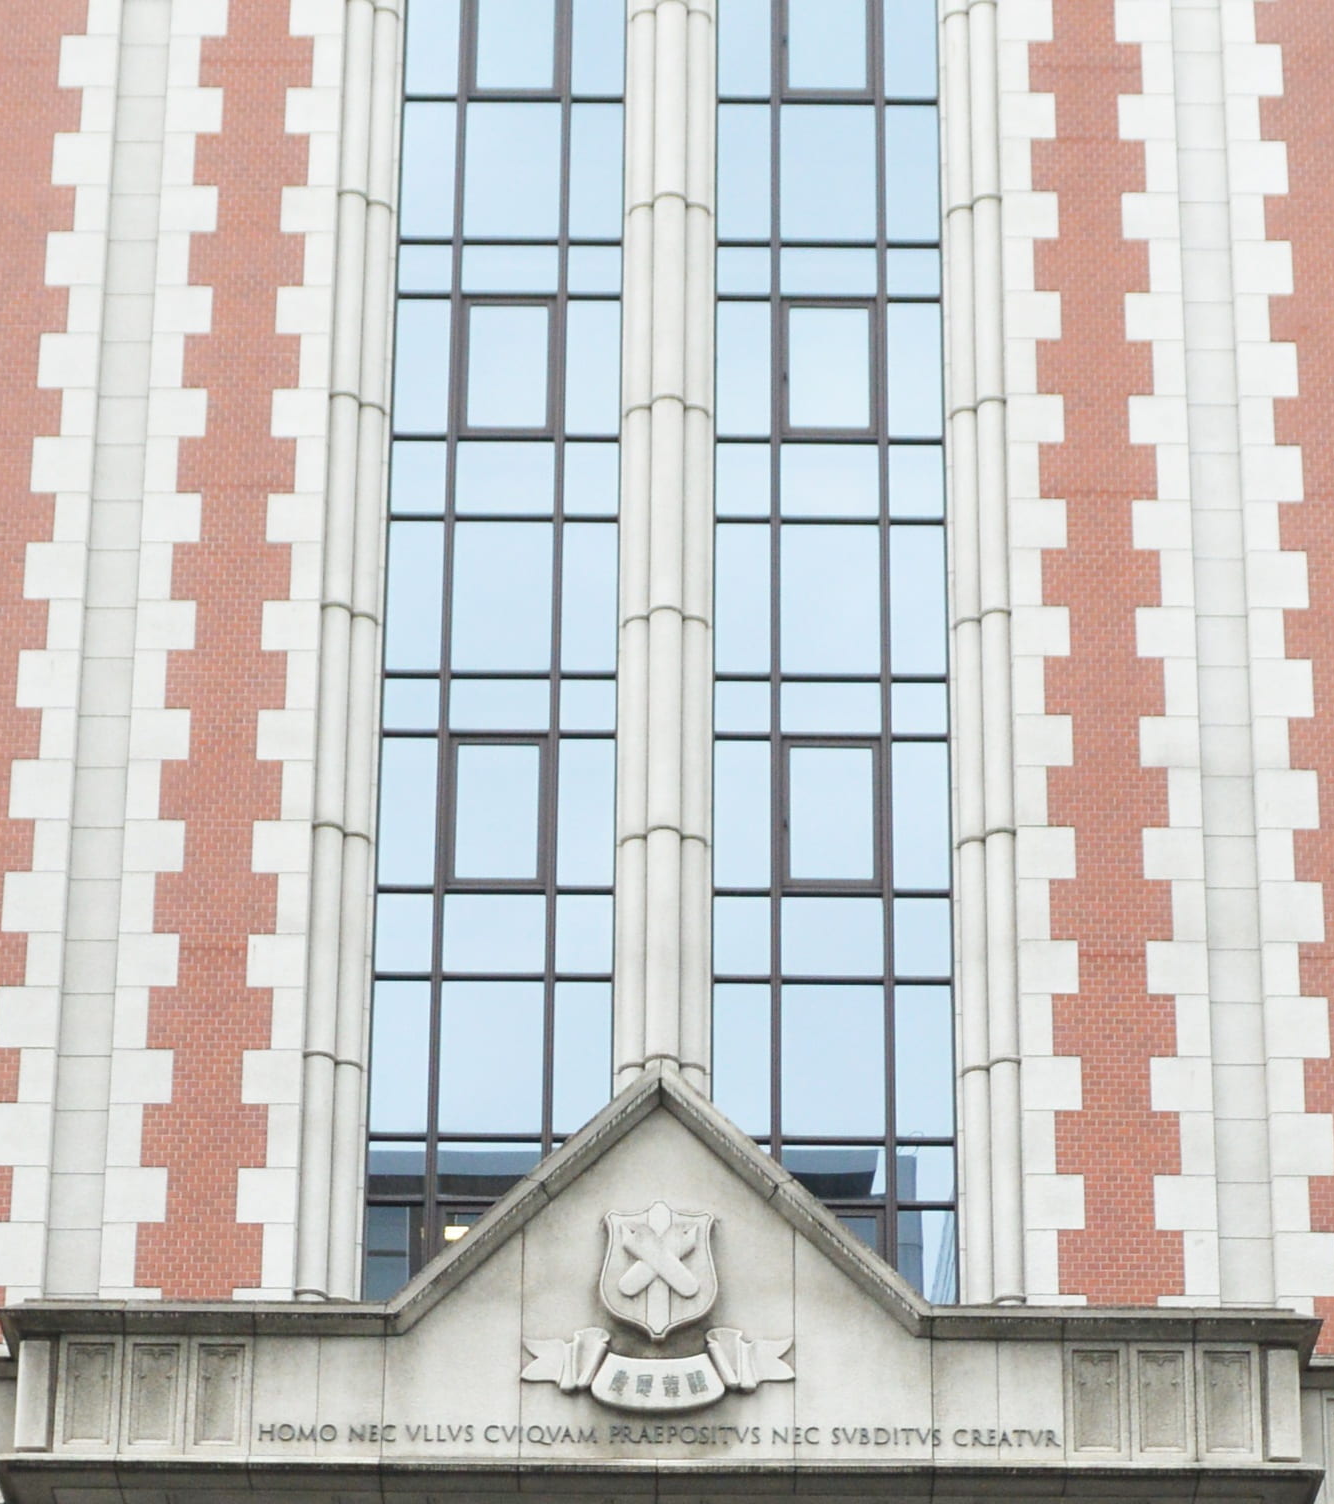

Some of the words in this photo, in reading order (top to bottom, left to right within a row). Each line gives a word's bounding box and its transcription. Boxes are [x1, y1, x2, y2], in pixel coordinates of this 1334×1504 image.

[257, 1423, 338, 1442] HOMO
[347, 1424, 397, 1442] NEC
[405, 1424, 474, 1443] VLLVS
[483, 1424, 598, 1446] CVIQVAM
[609, 1425, 761, 1446] PRAEPOSITVS
[771, 1426, 820, 1445] NEC
[831, 1426, 941, 1447] SVBDITVS
[952, 1428, 1062, 1448] CREATVR
